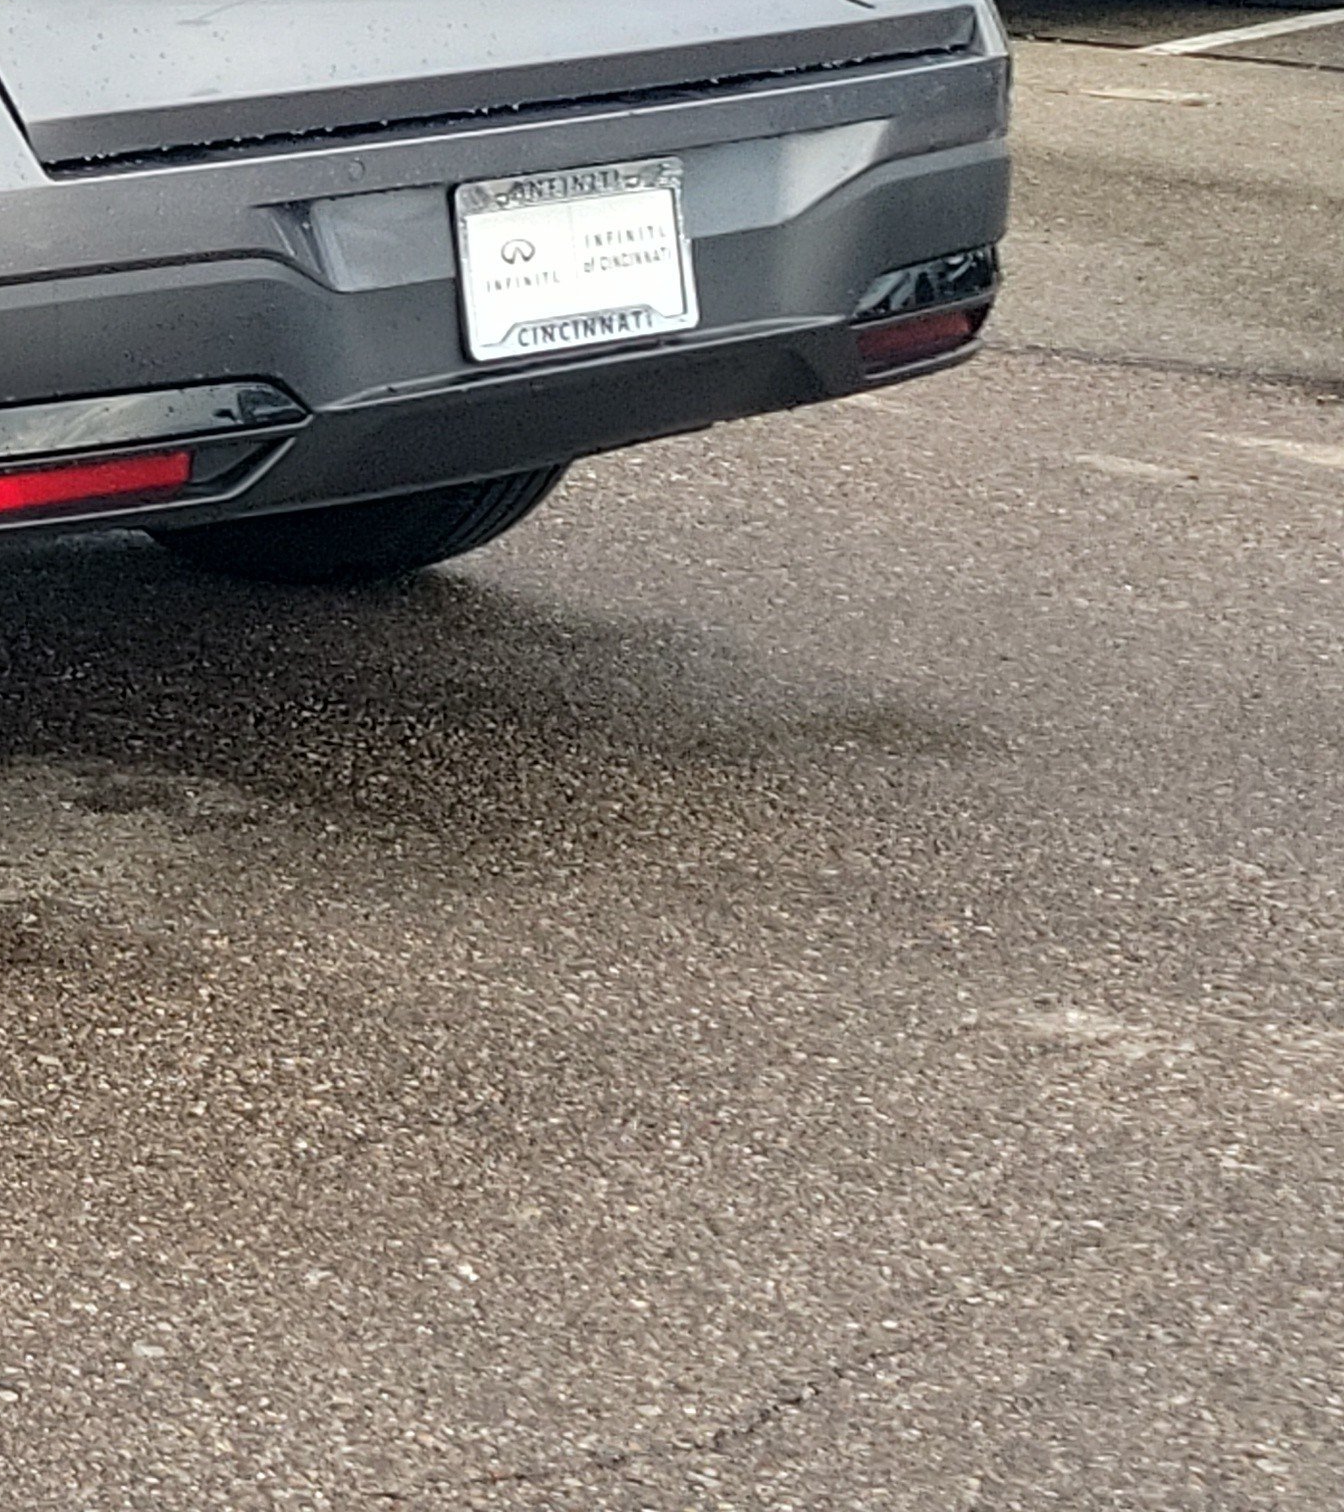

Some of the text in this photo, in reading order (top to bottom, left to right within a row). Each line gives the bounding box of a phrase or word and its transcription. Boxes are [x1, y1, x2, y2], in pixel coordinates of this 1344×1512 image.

[585, 225, 667, 248] INFINITI
[486, 270, 561, 293] INFINITI
[517, 309, 654, 348] CINCINNATI
